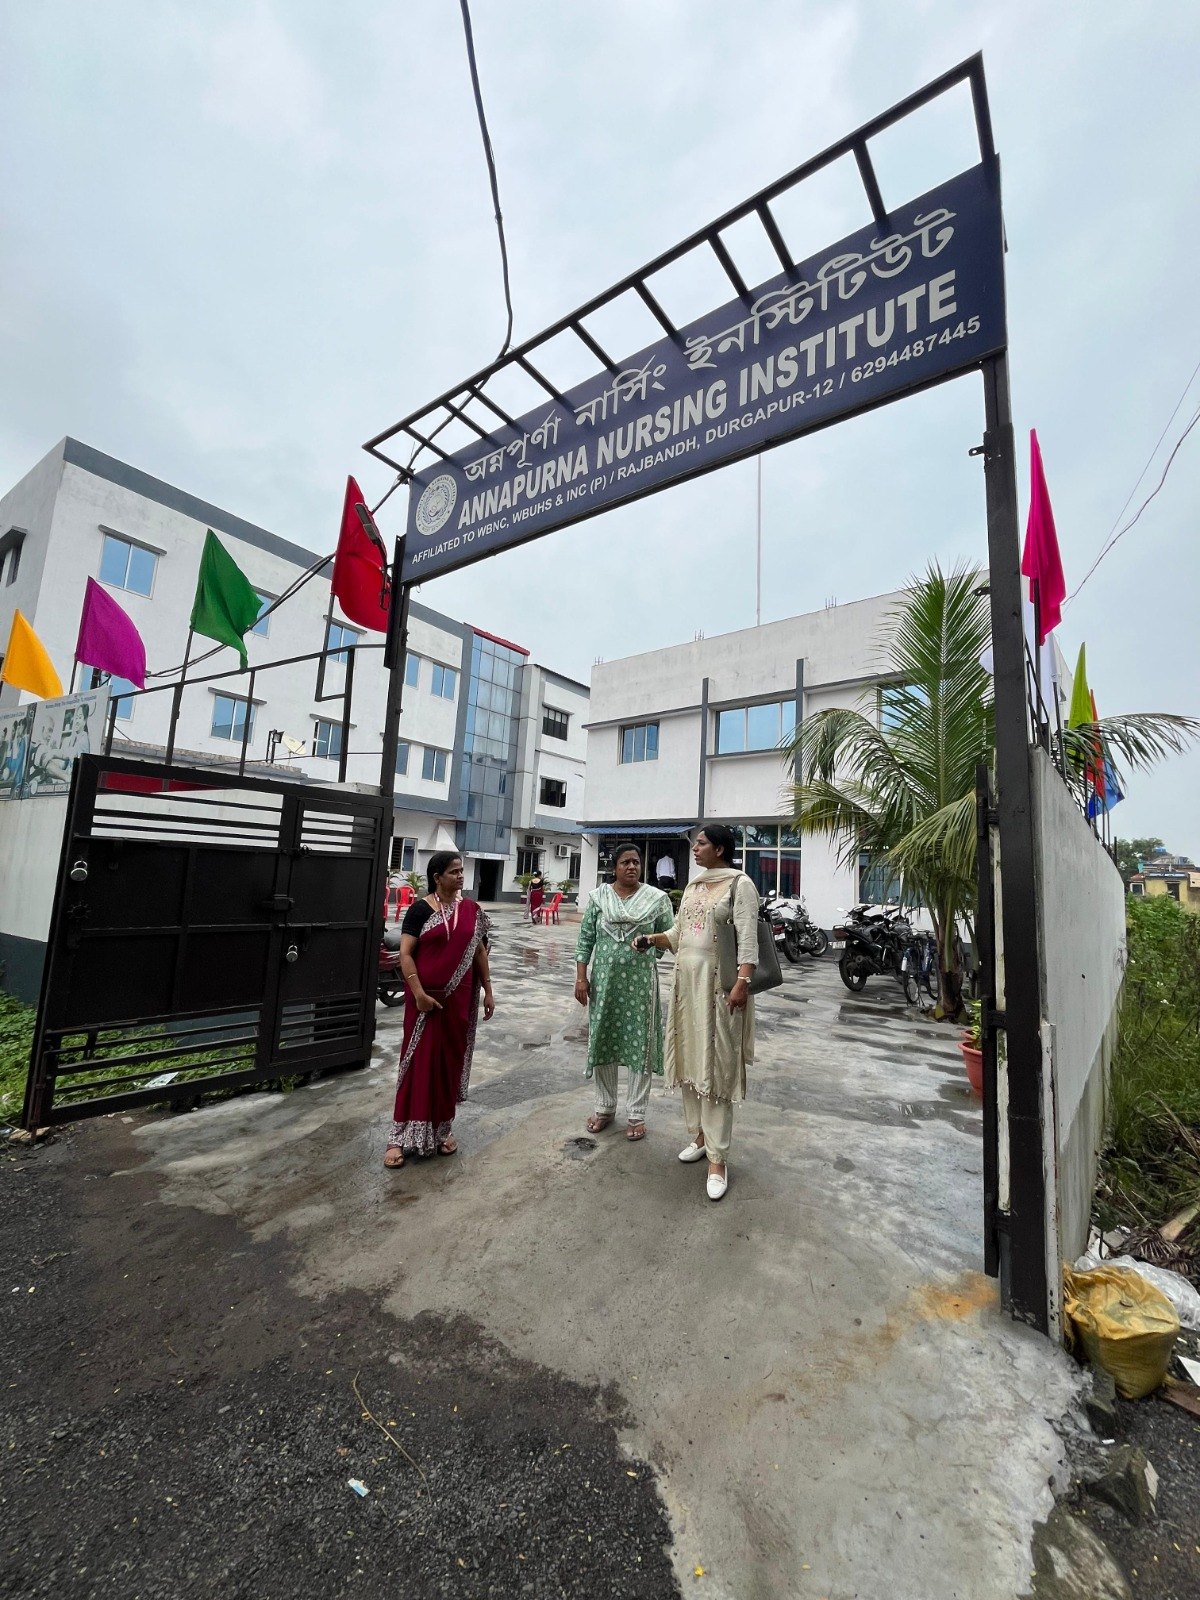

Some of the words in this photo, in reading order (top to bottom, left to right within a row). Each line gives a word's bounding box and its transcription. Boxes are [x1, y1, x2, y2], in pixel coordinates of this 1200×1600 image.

[411, 536, 460, 565] AFFILIATED
[463, 530, 475, 544] TO
[477, 517, 509, 539] WBNC,
[512, 497, 553, 524] WBUHS
[555, 493, 564, 506] &
[566, 483, 587, 502] INC
[590, 474, 606, 495] (P)
[609, 470, 615, 484] /
[617, 435, 700, 481] RAJBANDH,
[705, 378, 834, 444] DURGAPUR-12
[838, 371, 846, 389] /
[851, 315, 981, 383] 6294487445
[457, 444, 589, 530] ANNAPURNA
[596, 379, 727, 469] NURSING
[739, 269, 957, 407] INSTITUTE
[574, 354, 667, 426] নার্সিং
[683, 208, 957, 371] ইনস্টিটিউট
